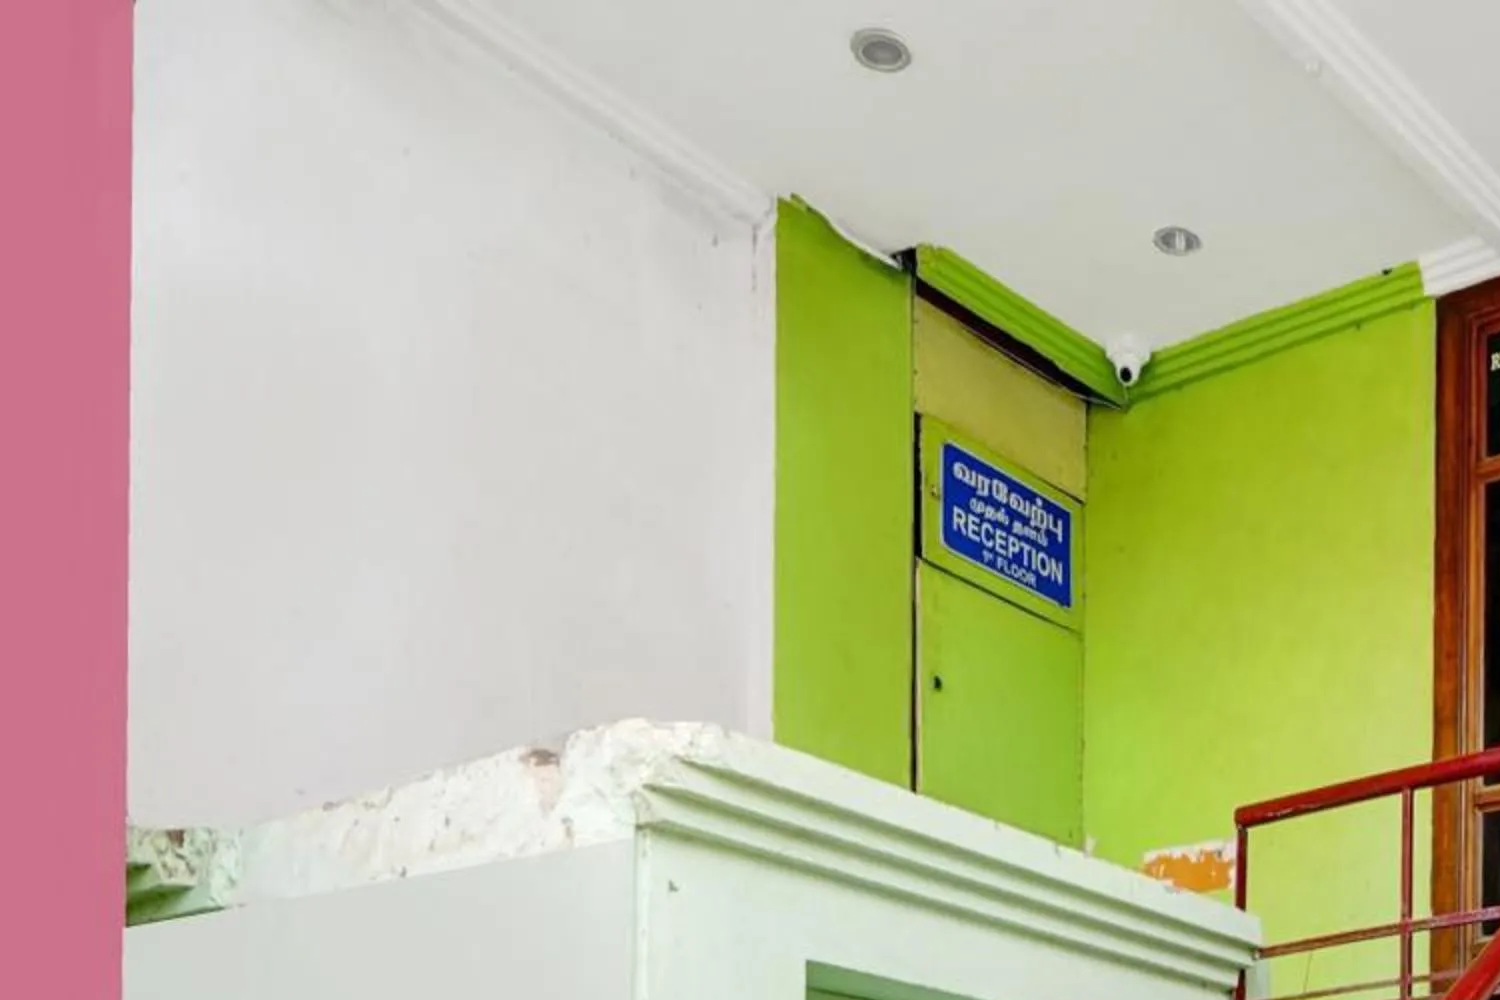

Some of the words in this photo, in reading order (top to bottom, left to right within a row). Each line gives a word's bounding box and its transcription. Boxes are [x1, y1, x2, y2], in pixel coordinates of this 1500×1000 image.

[952, 461, 1063, 542] வரவேற்பு
[952, 506, 1063, 585] RECEPTION
[997, 557, 1037, 588] FLOOR
